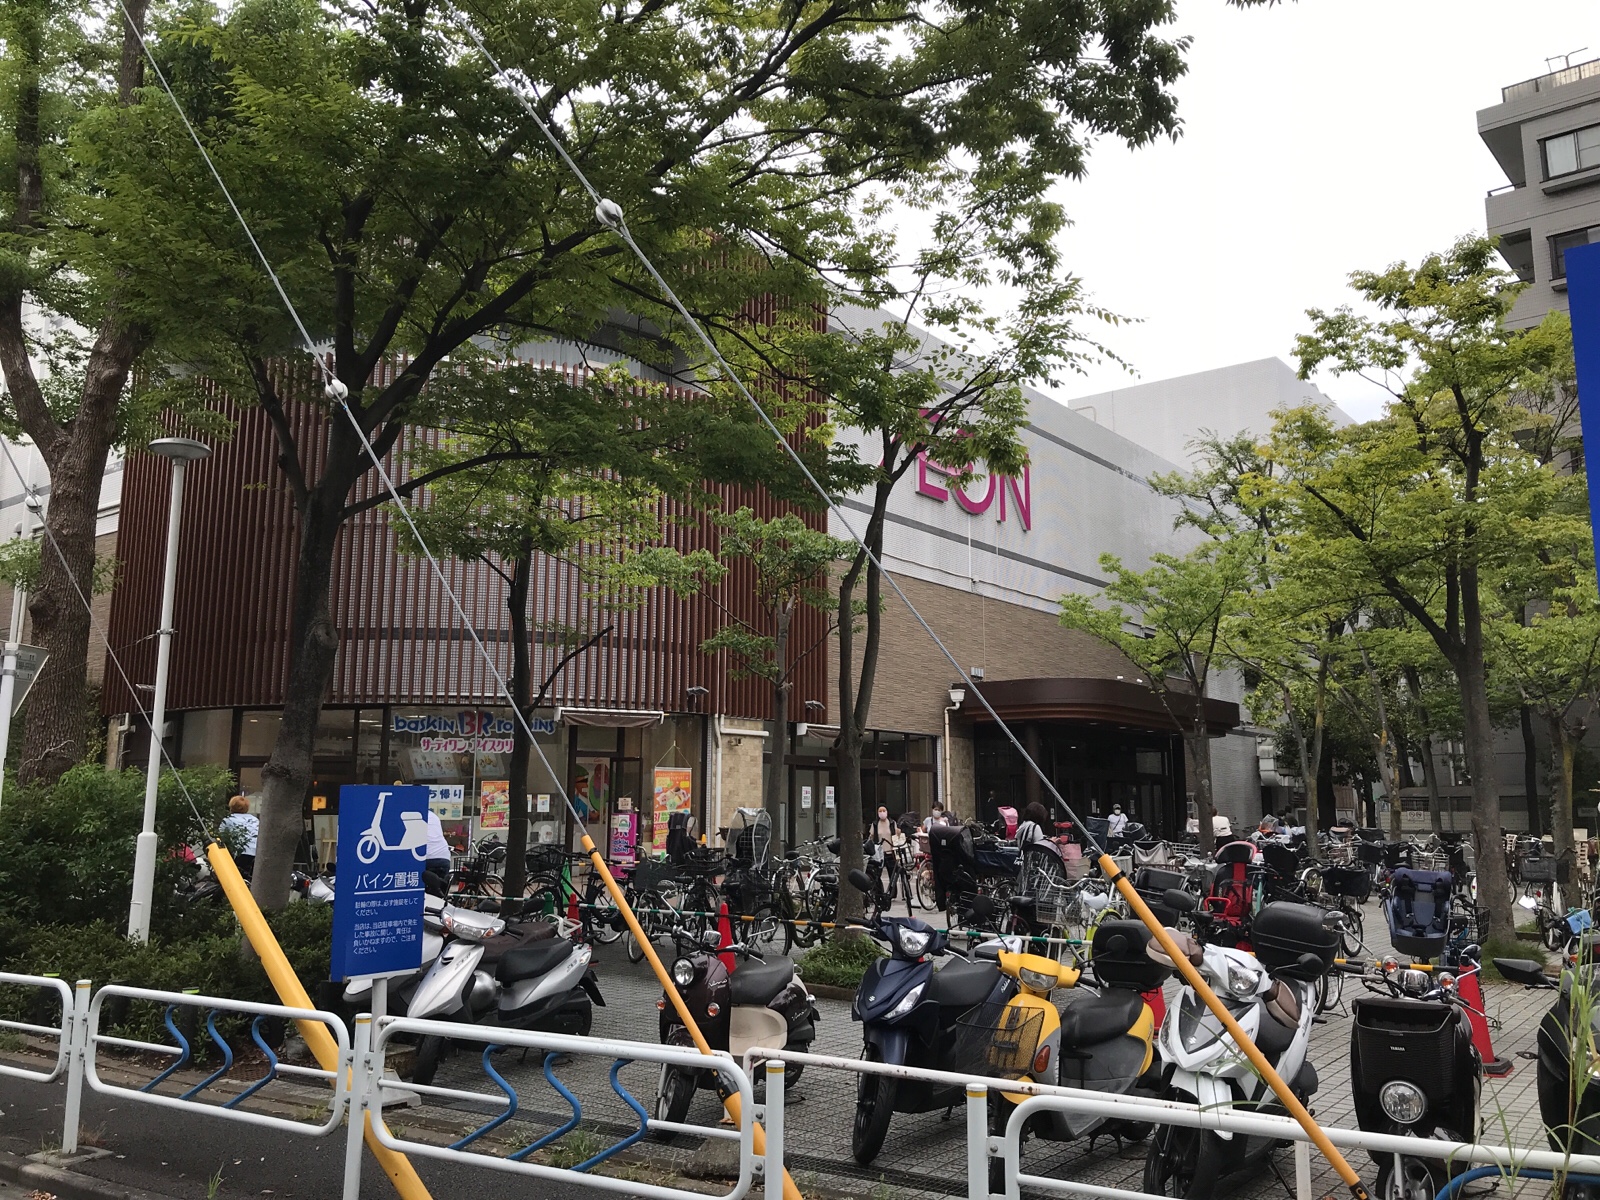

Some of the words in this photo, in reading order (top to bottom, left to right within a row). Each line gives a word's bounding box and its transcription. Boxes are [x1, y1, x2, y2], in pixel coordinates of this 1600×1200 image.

[881, 408, 1031, 530] EON
[355, 872, 419, 889] バイク置場
